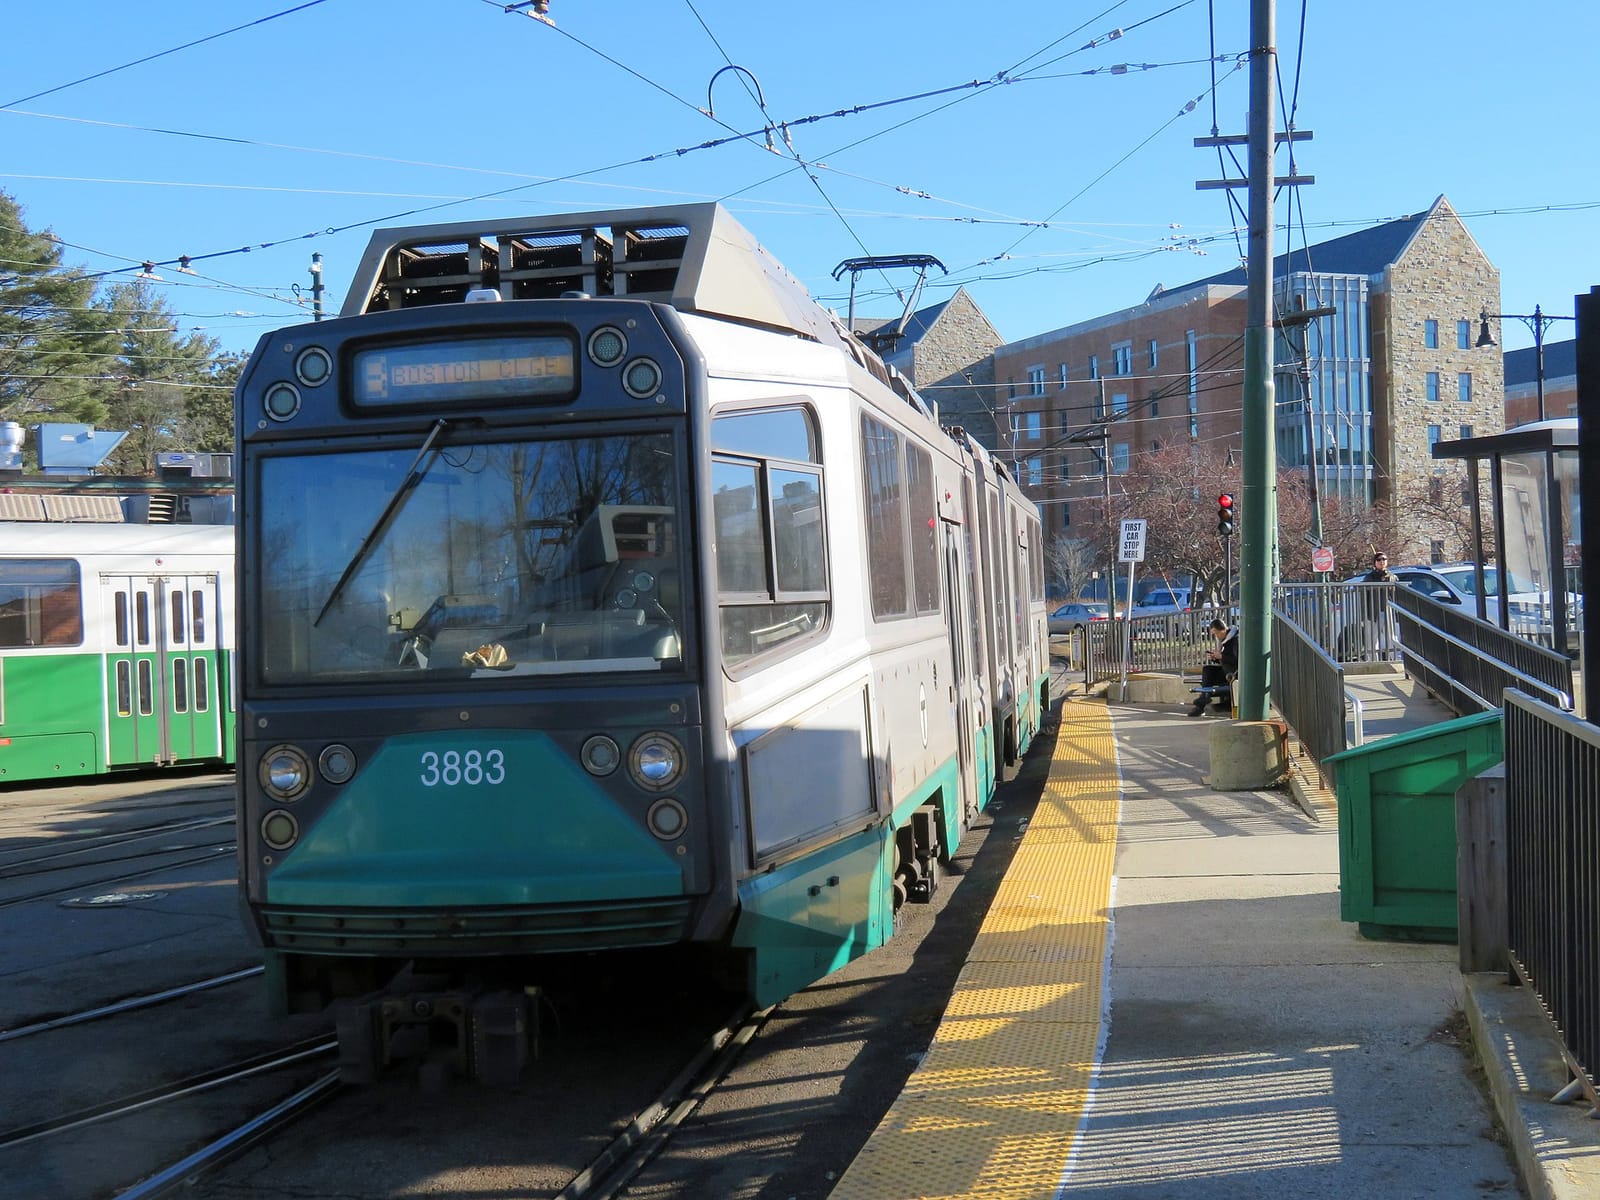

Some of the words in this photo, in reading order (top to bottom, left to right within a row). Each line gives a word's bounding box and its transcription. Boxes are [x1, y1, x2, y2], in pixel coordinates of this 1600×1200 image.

[1124, 523, 1141, 531] FIRST
[1126, 532, 1139, 540] CAR
[1123, 541, 1140, 549] STOP
[1123, 550, 1139, 558] HERE
[420, 748, 505, 787] 3883
